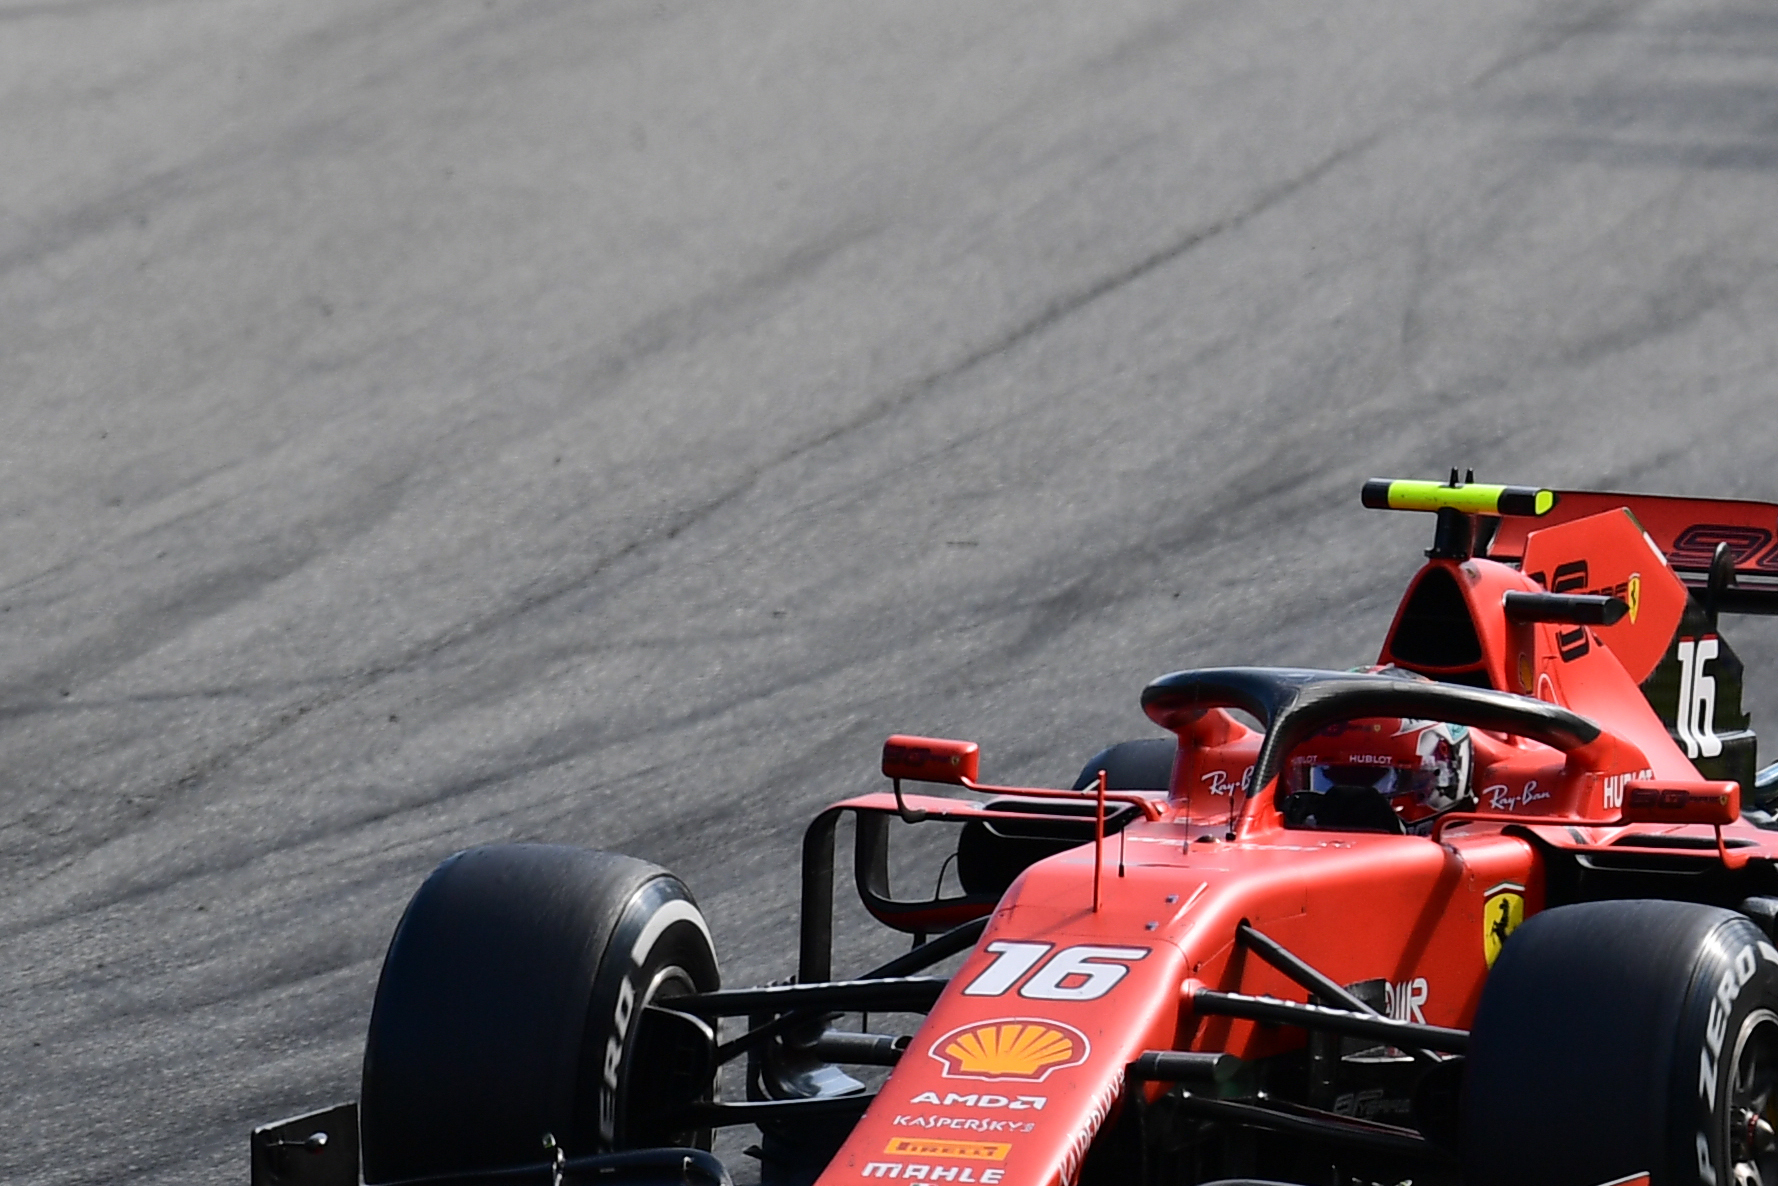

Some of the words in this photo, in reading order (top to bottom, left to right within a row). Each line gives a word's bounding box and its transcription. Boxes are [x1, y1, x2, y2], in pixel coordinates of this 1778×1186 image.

[1677, 634, 1723, 759] 16
[1349, 754, 1392, 765] HUBLOT
[962, 939, 1152, 1002] 16
[910, 1091, 1010, 1109] AMD
[892, 1114, 1024, 1133] KASPERSKY
[861, 1161, 1005, 1185] MAHLE
